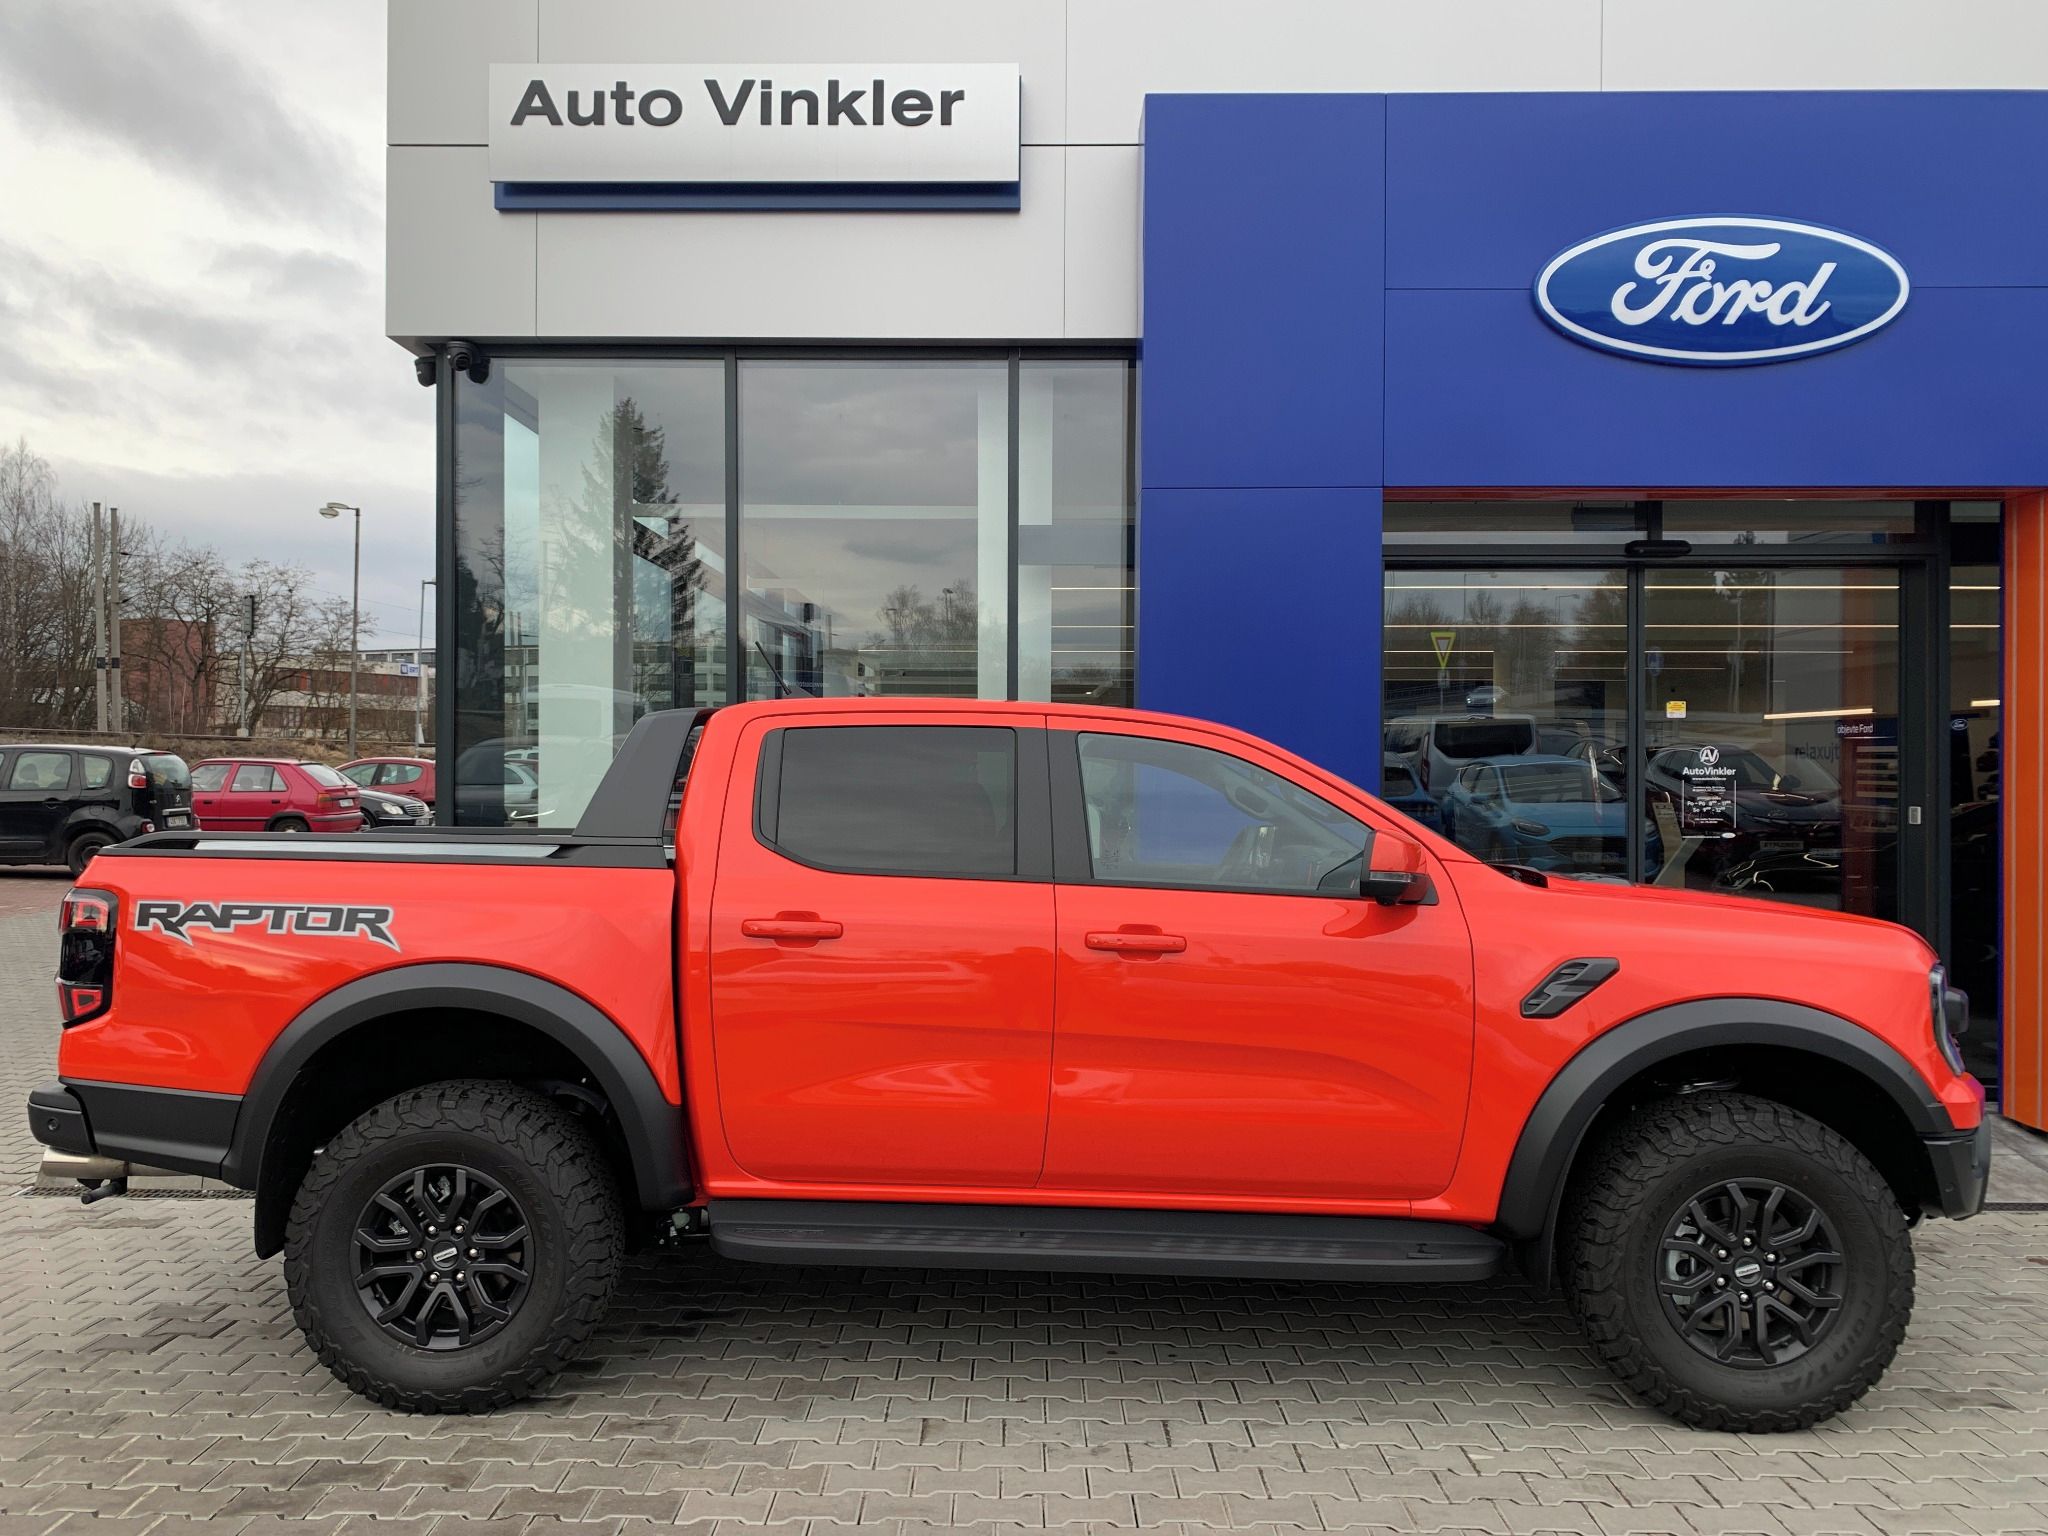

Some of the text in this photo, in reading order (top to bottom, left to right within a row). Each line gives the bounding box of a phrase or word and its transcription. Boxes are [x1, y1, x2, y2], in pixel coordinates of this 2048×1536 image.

[510, 79, 965, 127] Auto Vinkler
[1611, 238, 1837, 326] Ford
[1859, 723, 1874, 733] Ford
[1682, 767, 1736, 775] AutoVinkler
[134, 900, 401, 952] RAPTOR
